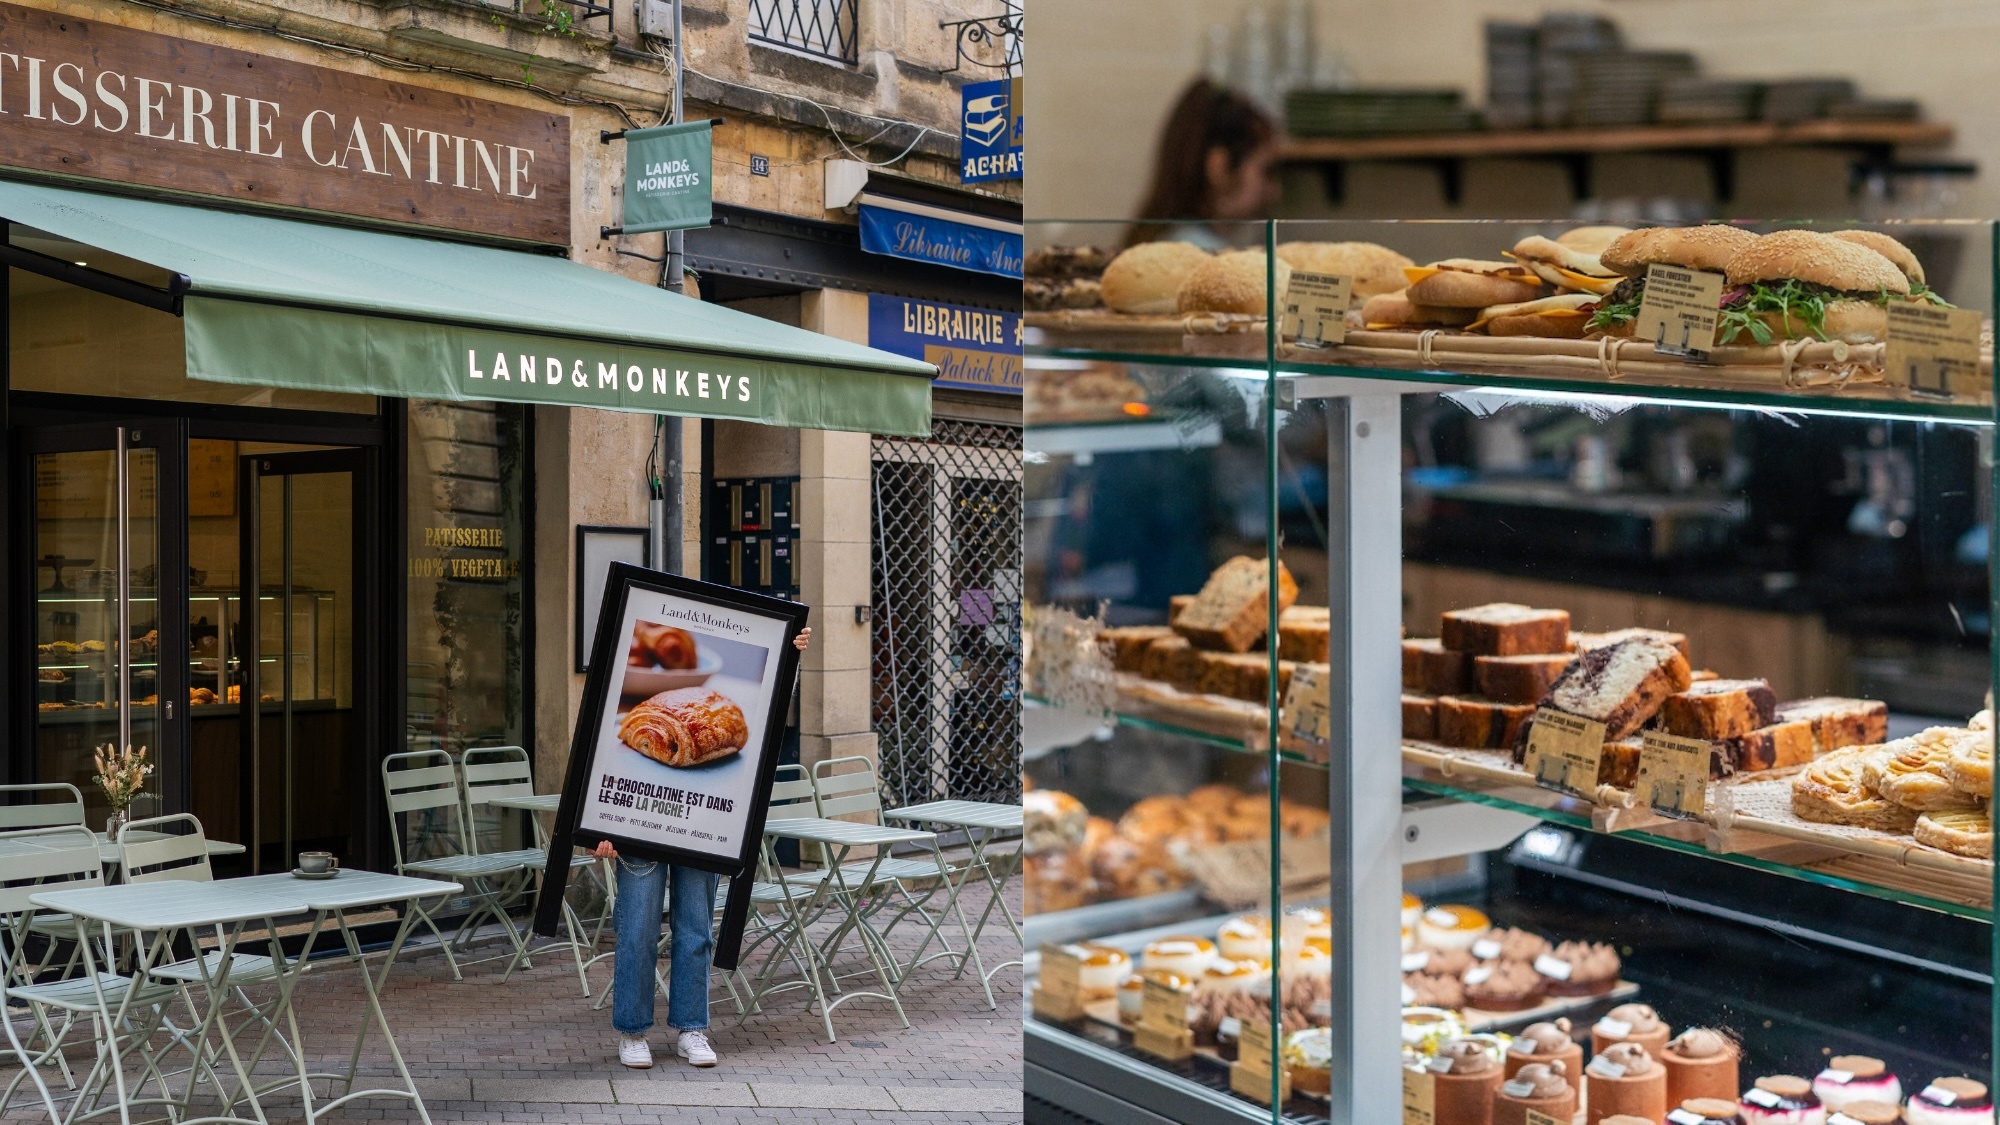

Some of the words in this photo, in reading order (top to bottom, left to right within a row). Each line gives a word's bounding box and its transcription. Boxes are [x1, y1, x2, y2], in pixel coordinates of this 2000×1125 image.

[301, 110, 537, 200] CANTINE
[645, 159, 690, 176] LAND&
[755, 160, 765, 172] 14
[637, 173, 700, 192] MONKEYS
[893, 222, 971, 264] Librairie
[1651, 268, 1665, 279] BAGEL
[1666, 271, 1692, 283] FORESTIER
[904, 302, 1003, 346] LIBRAIRIE
[469, 349, 751, 401] LAND&MONKEYS
[937, 350, 994, 383] Patrick
[425, 527, 503, 547] PATISSERIE
[408, 558, 444, 577] 100%
[451, 558, 518, 578] VEGETALE
[661, 604, 750, 635] Land&Monkeys
[599, 789, 611, 803] LE
[635, 796, 648, 812] LA
[651, 799, 684, 818] POCHE
[601, 774, 614, 789] LA
[617, 777, 685, 803] CHOCOLATINE
[686, 791, 705, 807] EST
[706, 796, 734, 813] DANS
